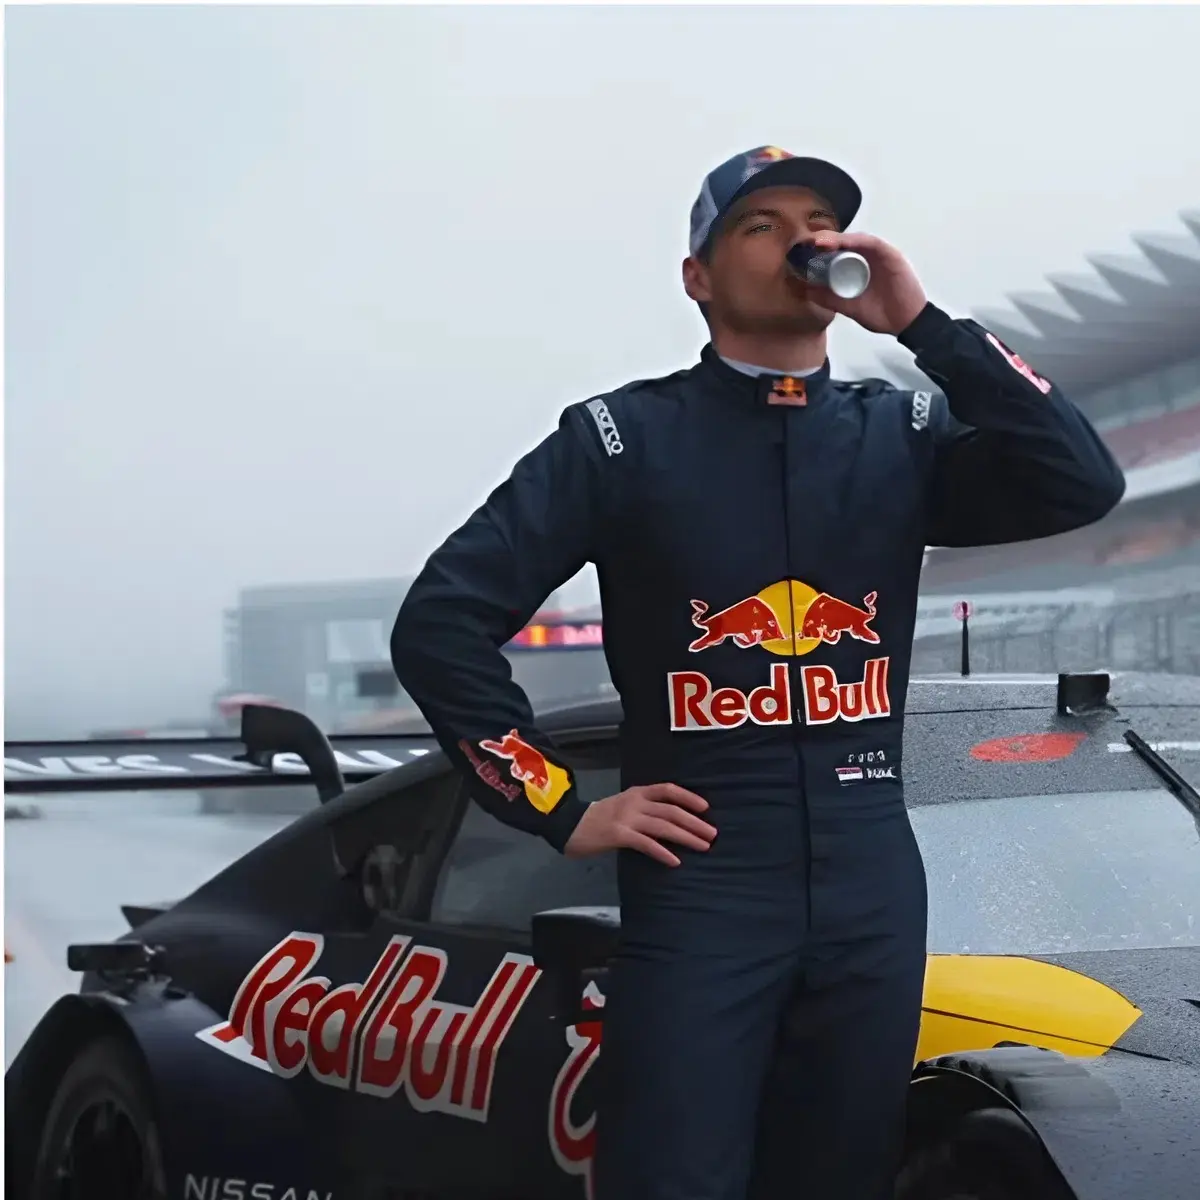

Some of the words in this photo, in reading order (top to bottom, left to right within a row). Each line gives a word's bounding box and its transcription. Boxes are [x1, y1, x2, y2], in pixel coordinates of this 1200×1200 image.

[667, 662, 792, 731] Red
[801, 656, 891, 726] Bull
[194, 930, 413, 1090] Red
[355, 944, 543, 1123] Bull
